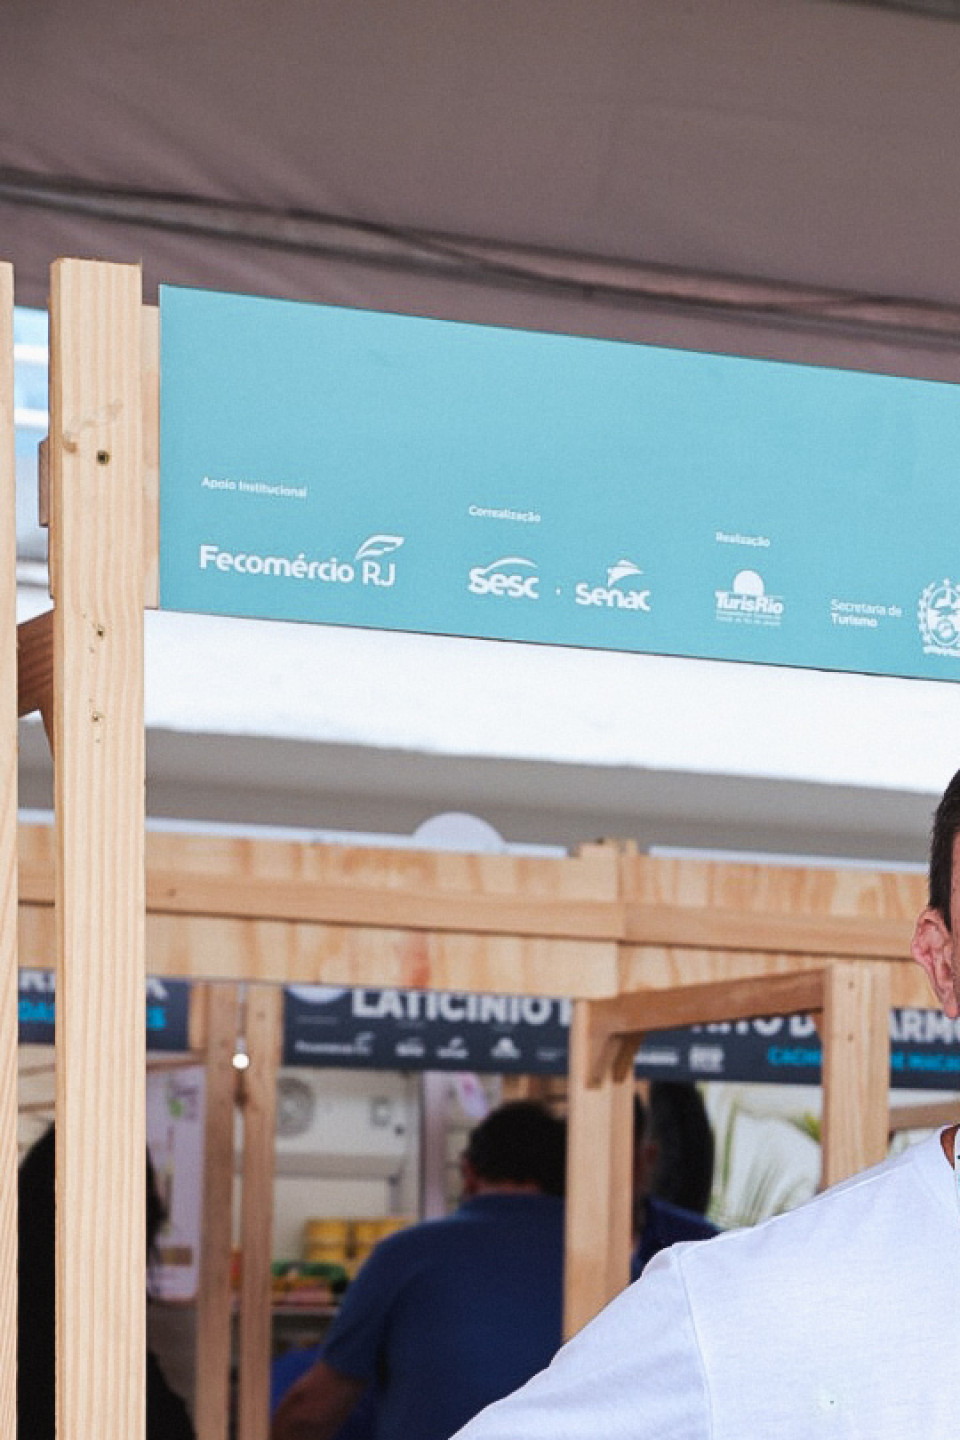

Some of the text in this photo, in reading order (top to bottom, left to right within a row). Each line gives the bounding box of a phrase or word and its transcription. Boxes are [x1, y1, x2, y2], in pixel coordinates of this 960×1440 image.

[201, 476, 308, 498] Apoio Institucional
[199, 544, 396, 587] Fecomércio RJ
[468, 566, 651, 612] Sesc Senac
[830, 598, 902, 618] Secretaria de
[830, 612, 879, 628] Turismo
